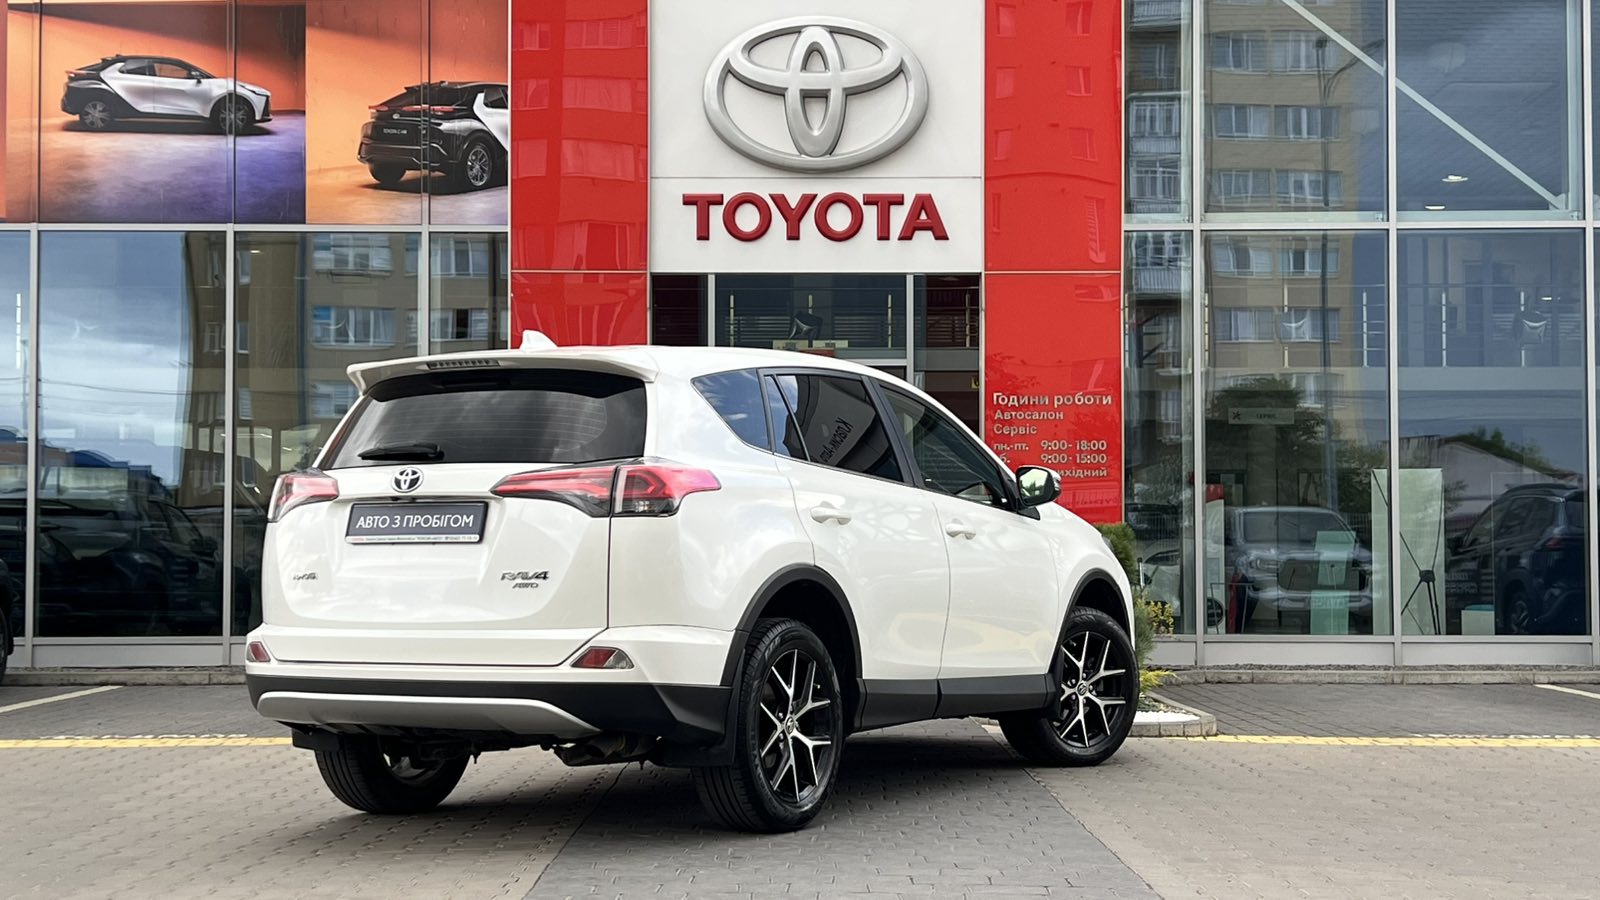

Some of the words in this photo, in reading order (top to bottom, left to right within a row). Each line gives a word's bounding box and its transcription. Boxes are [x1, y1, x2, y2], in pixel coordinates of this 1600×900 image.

[682, 191, 950, 242] TOYOTA
[993, 392, 1049, 407] Години
[1054, 392, 1112, 407] роботи
[994, 410, 1064, 420] Автосалон
[993, 423, 1038, 437] Сервіс
[997, 453, 1011, 464] б.
[1057, 467, 1107, 478] ихідний
[355, 515, 390, 529] АВТО
[403, 514, 474, 528] ПРОБІГОМ
[500, 571, 550, 581] RAV4
